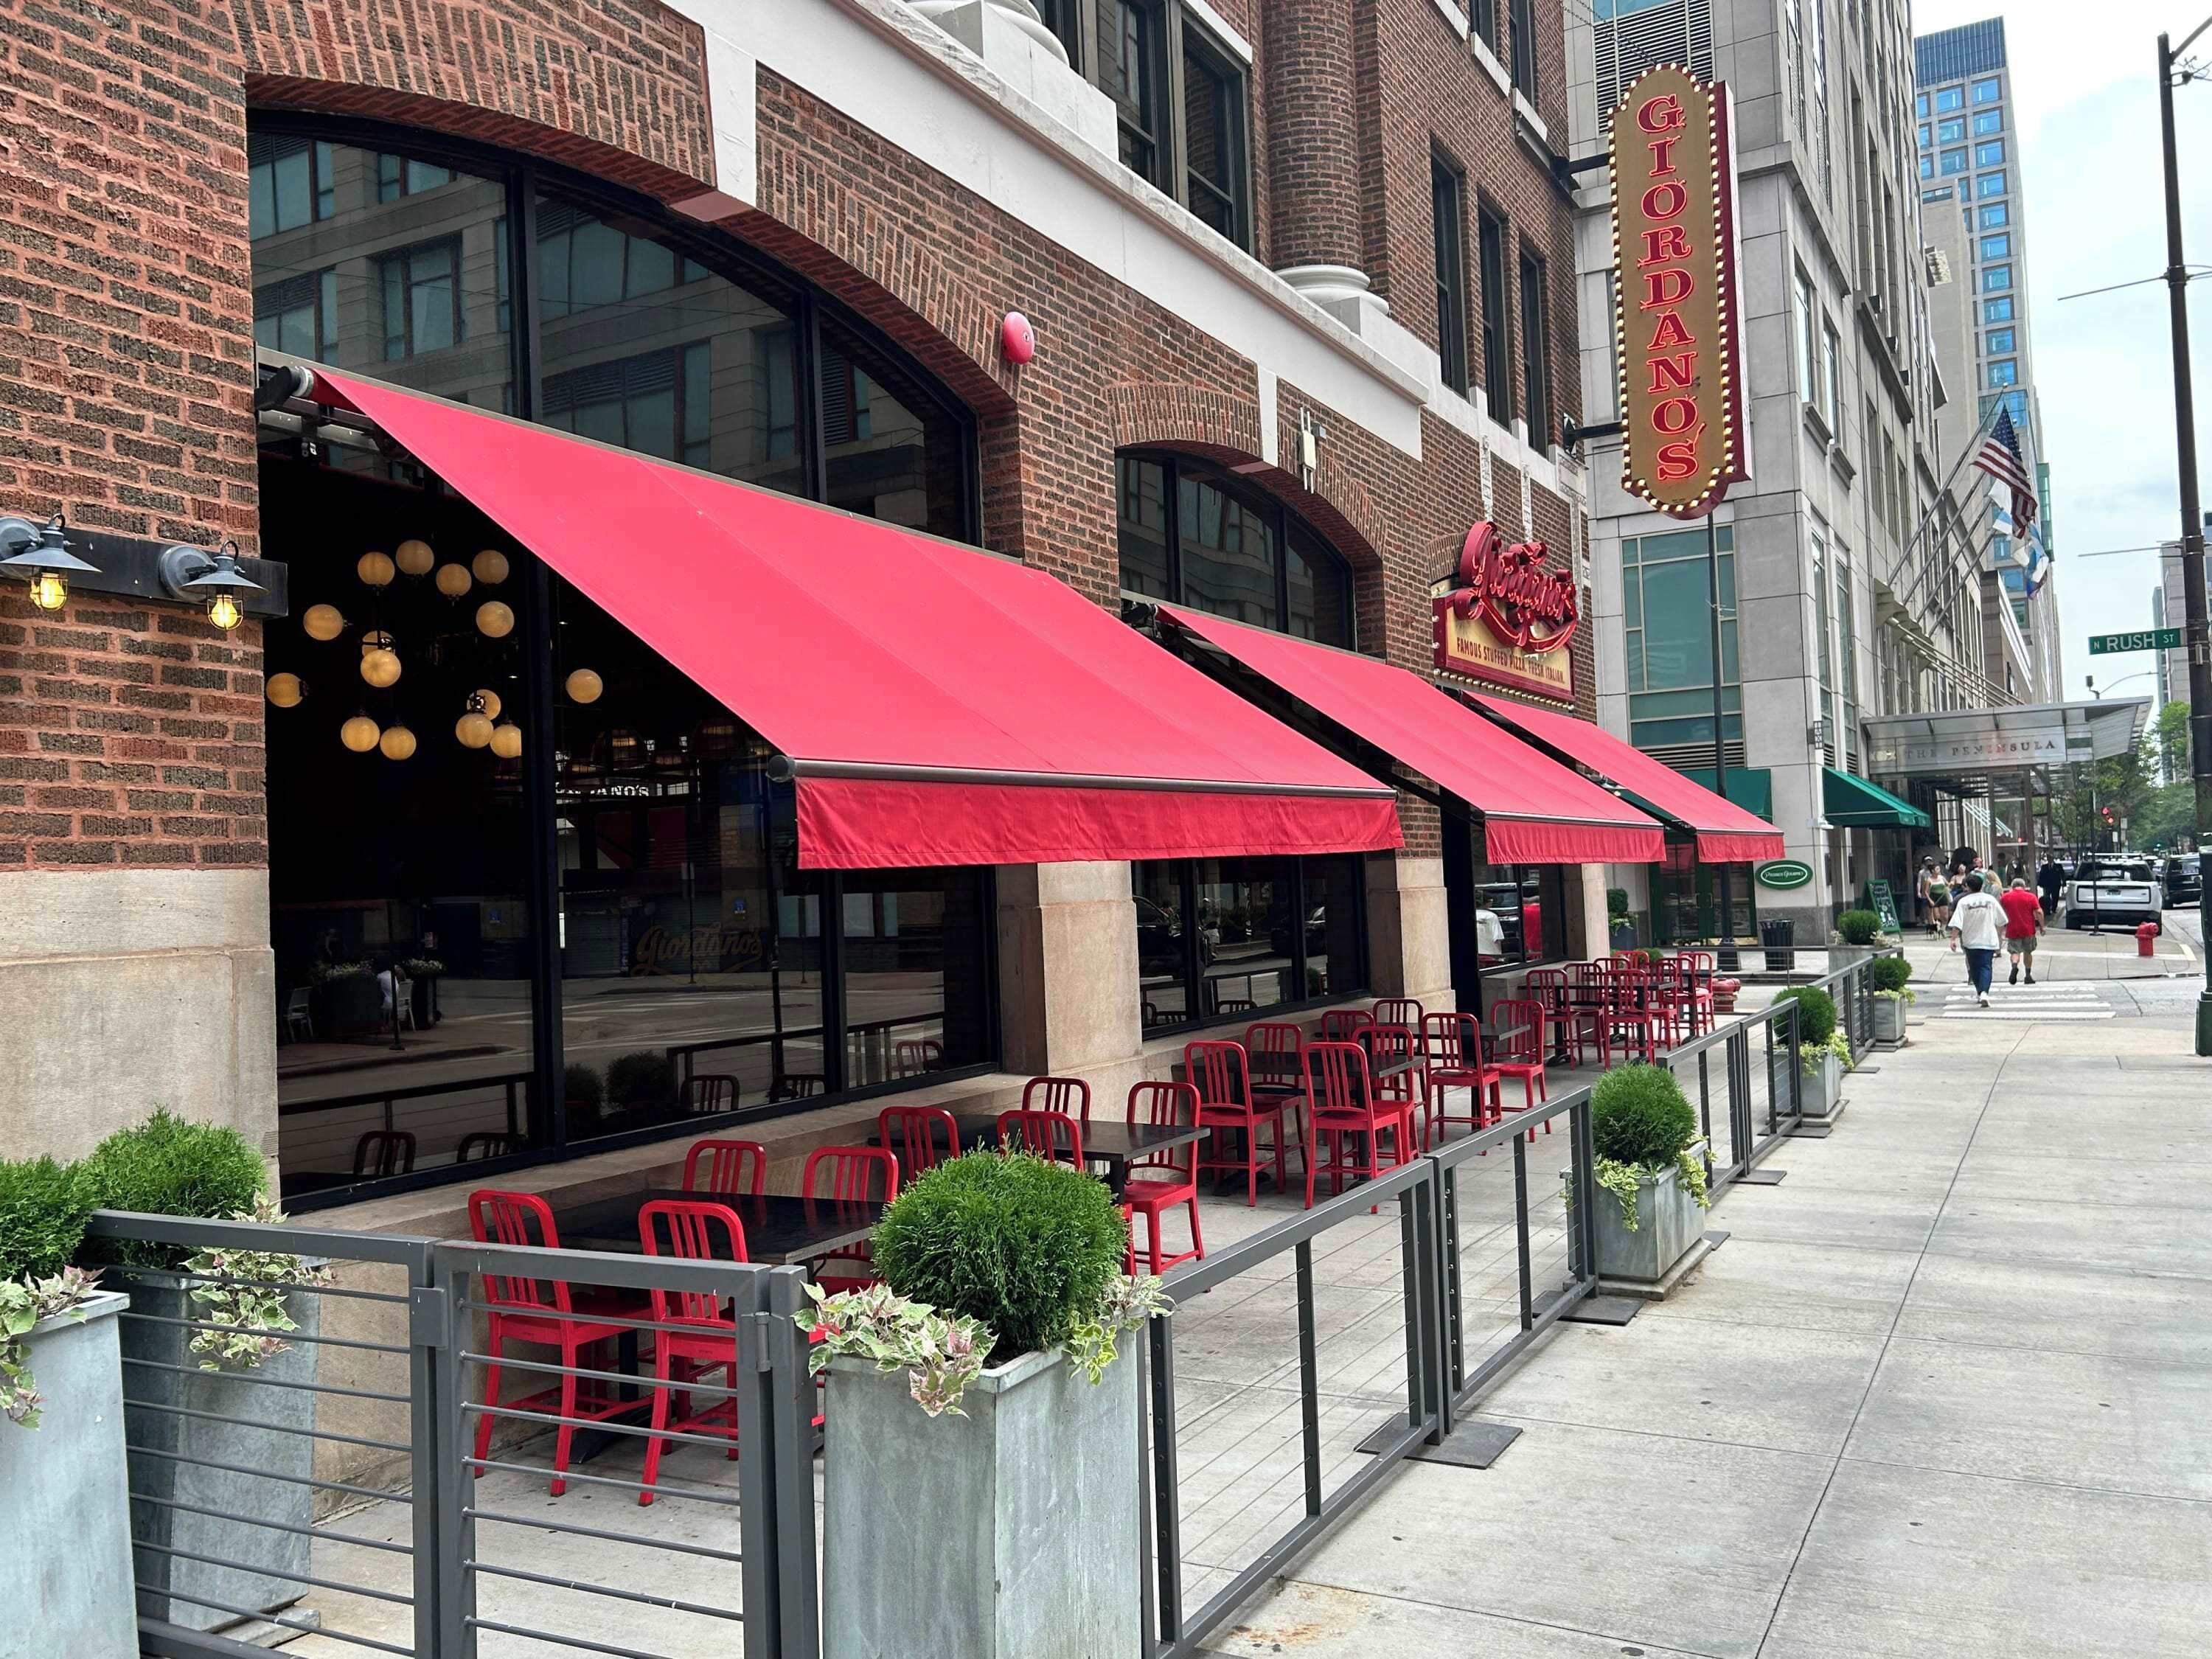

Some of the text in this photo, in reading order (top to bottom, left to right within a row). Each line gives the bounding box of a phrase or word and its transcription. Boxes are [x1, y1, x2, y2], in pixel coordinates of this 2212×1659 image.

[1636, 94, 1705, 481] GIORDANO'S
[2093, 633, 2174, 651] N RUSH ST
[1457, 637, 1482, 659] FAMOUS
[1483, 646, 1508, 667] STUFFED
[1528, 659, 1545, 678] FRESH
[1905, 740, 2056, 759] THE PENINSULA
